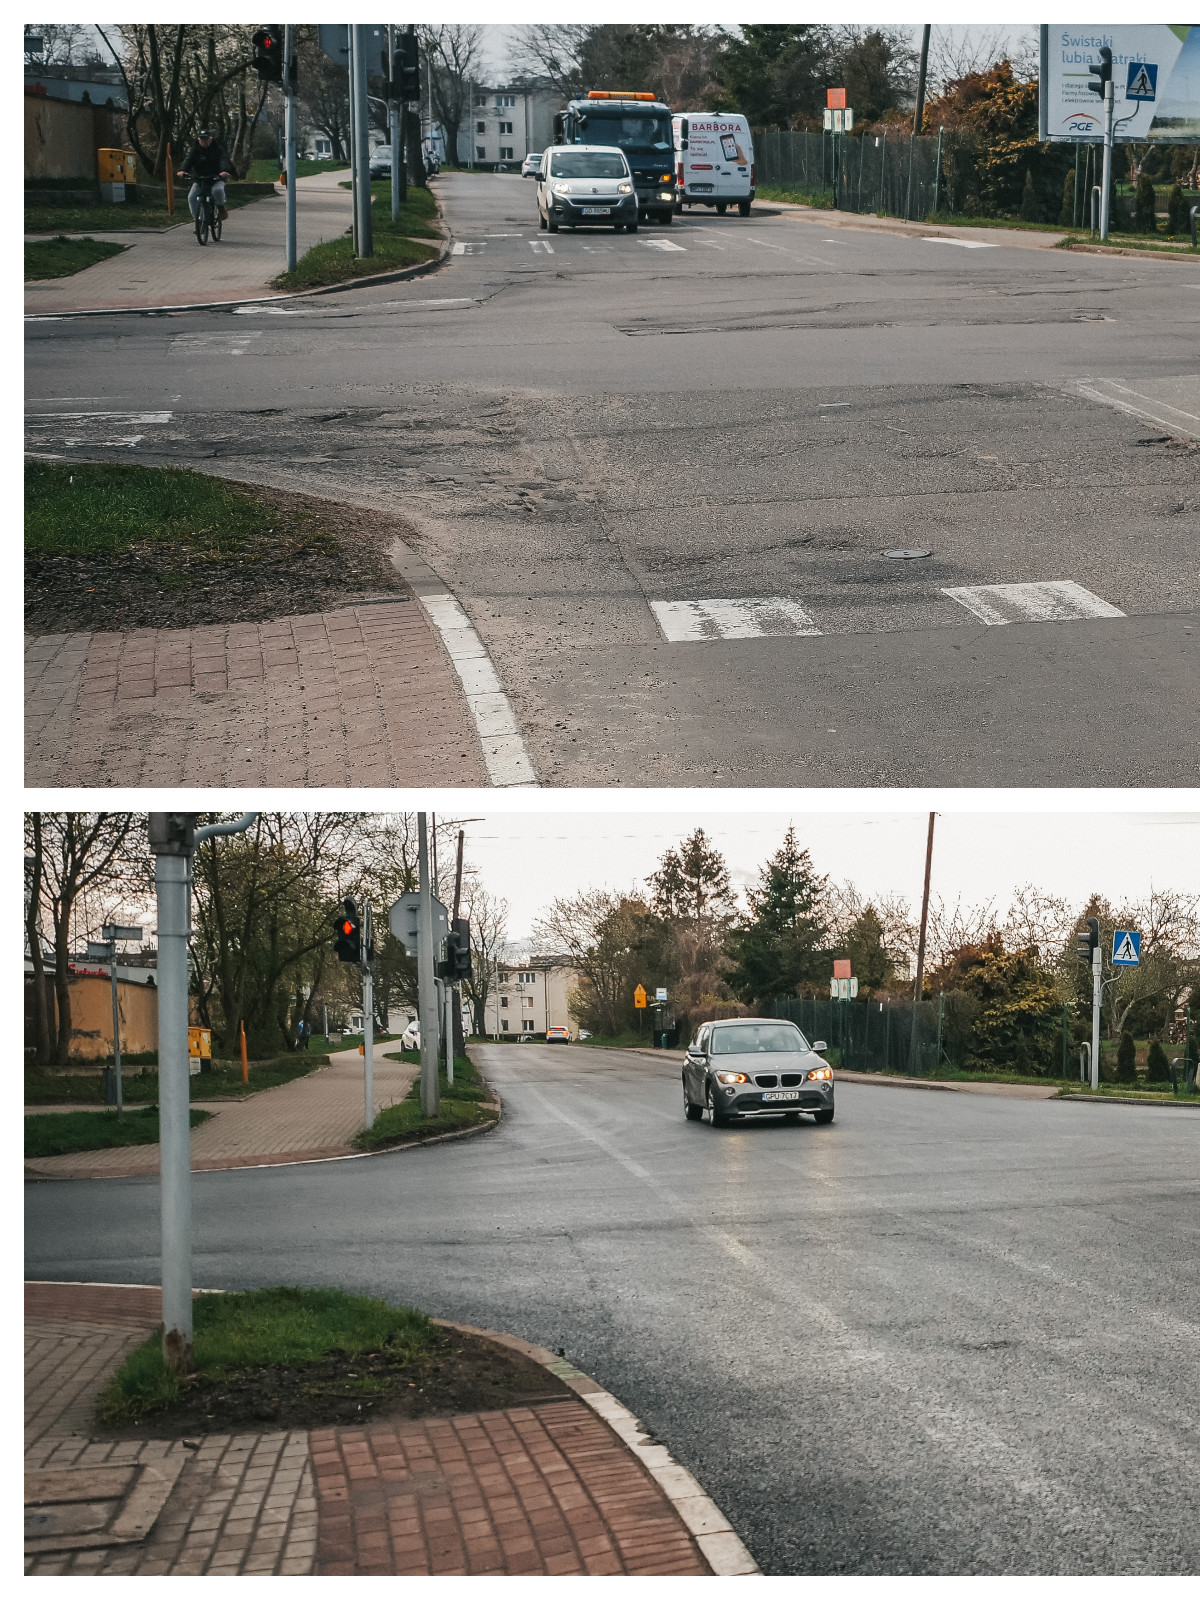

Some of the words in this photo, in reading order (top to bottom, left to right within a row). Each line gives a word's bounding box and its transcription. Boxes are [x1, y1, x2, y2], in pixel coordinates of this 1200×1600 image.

[1061, 32, 1113, 47] Świstaki
[1062, 51, 1094, 64] lubią
[691, 123, 742, 132] BARBORA
[1069, 122, 1094, 131] PGE
